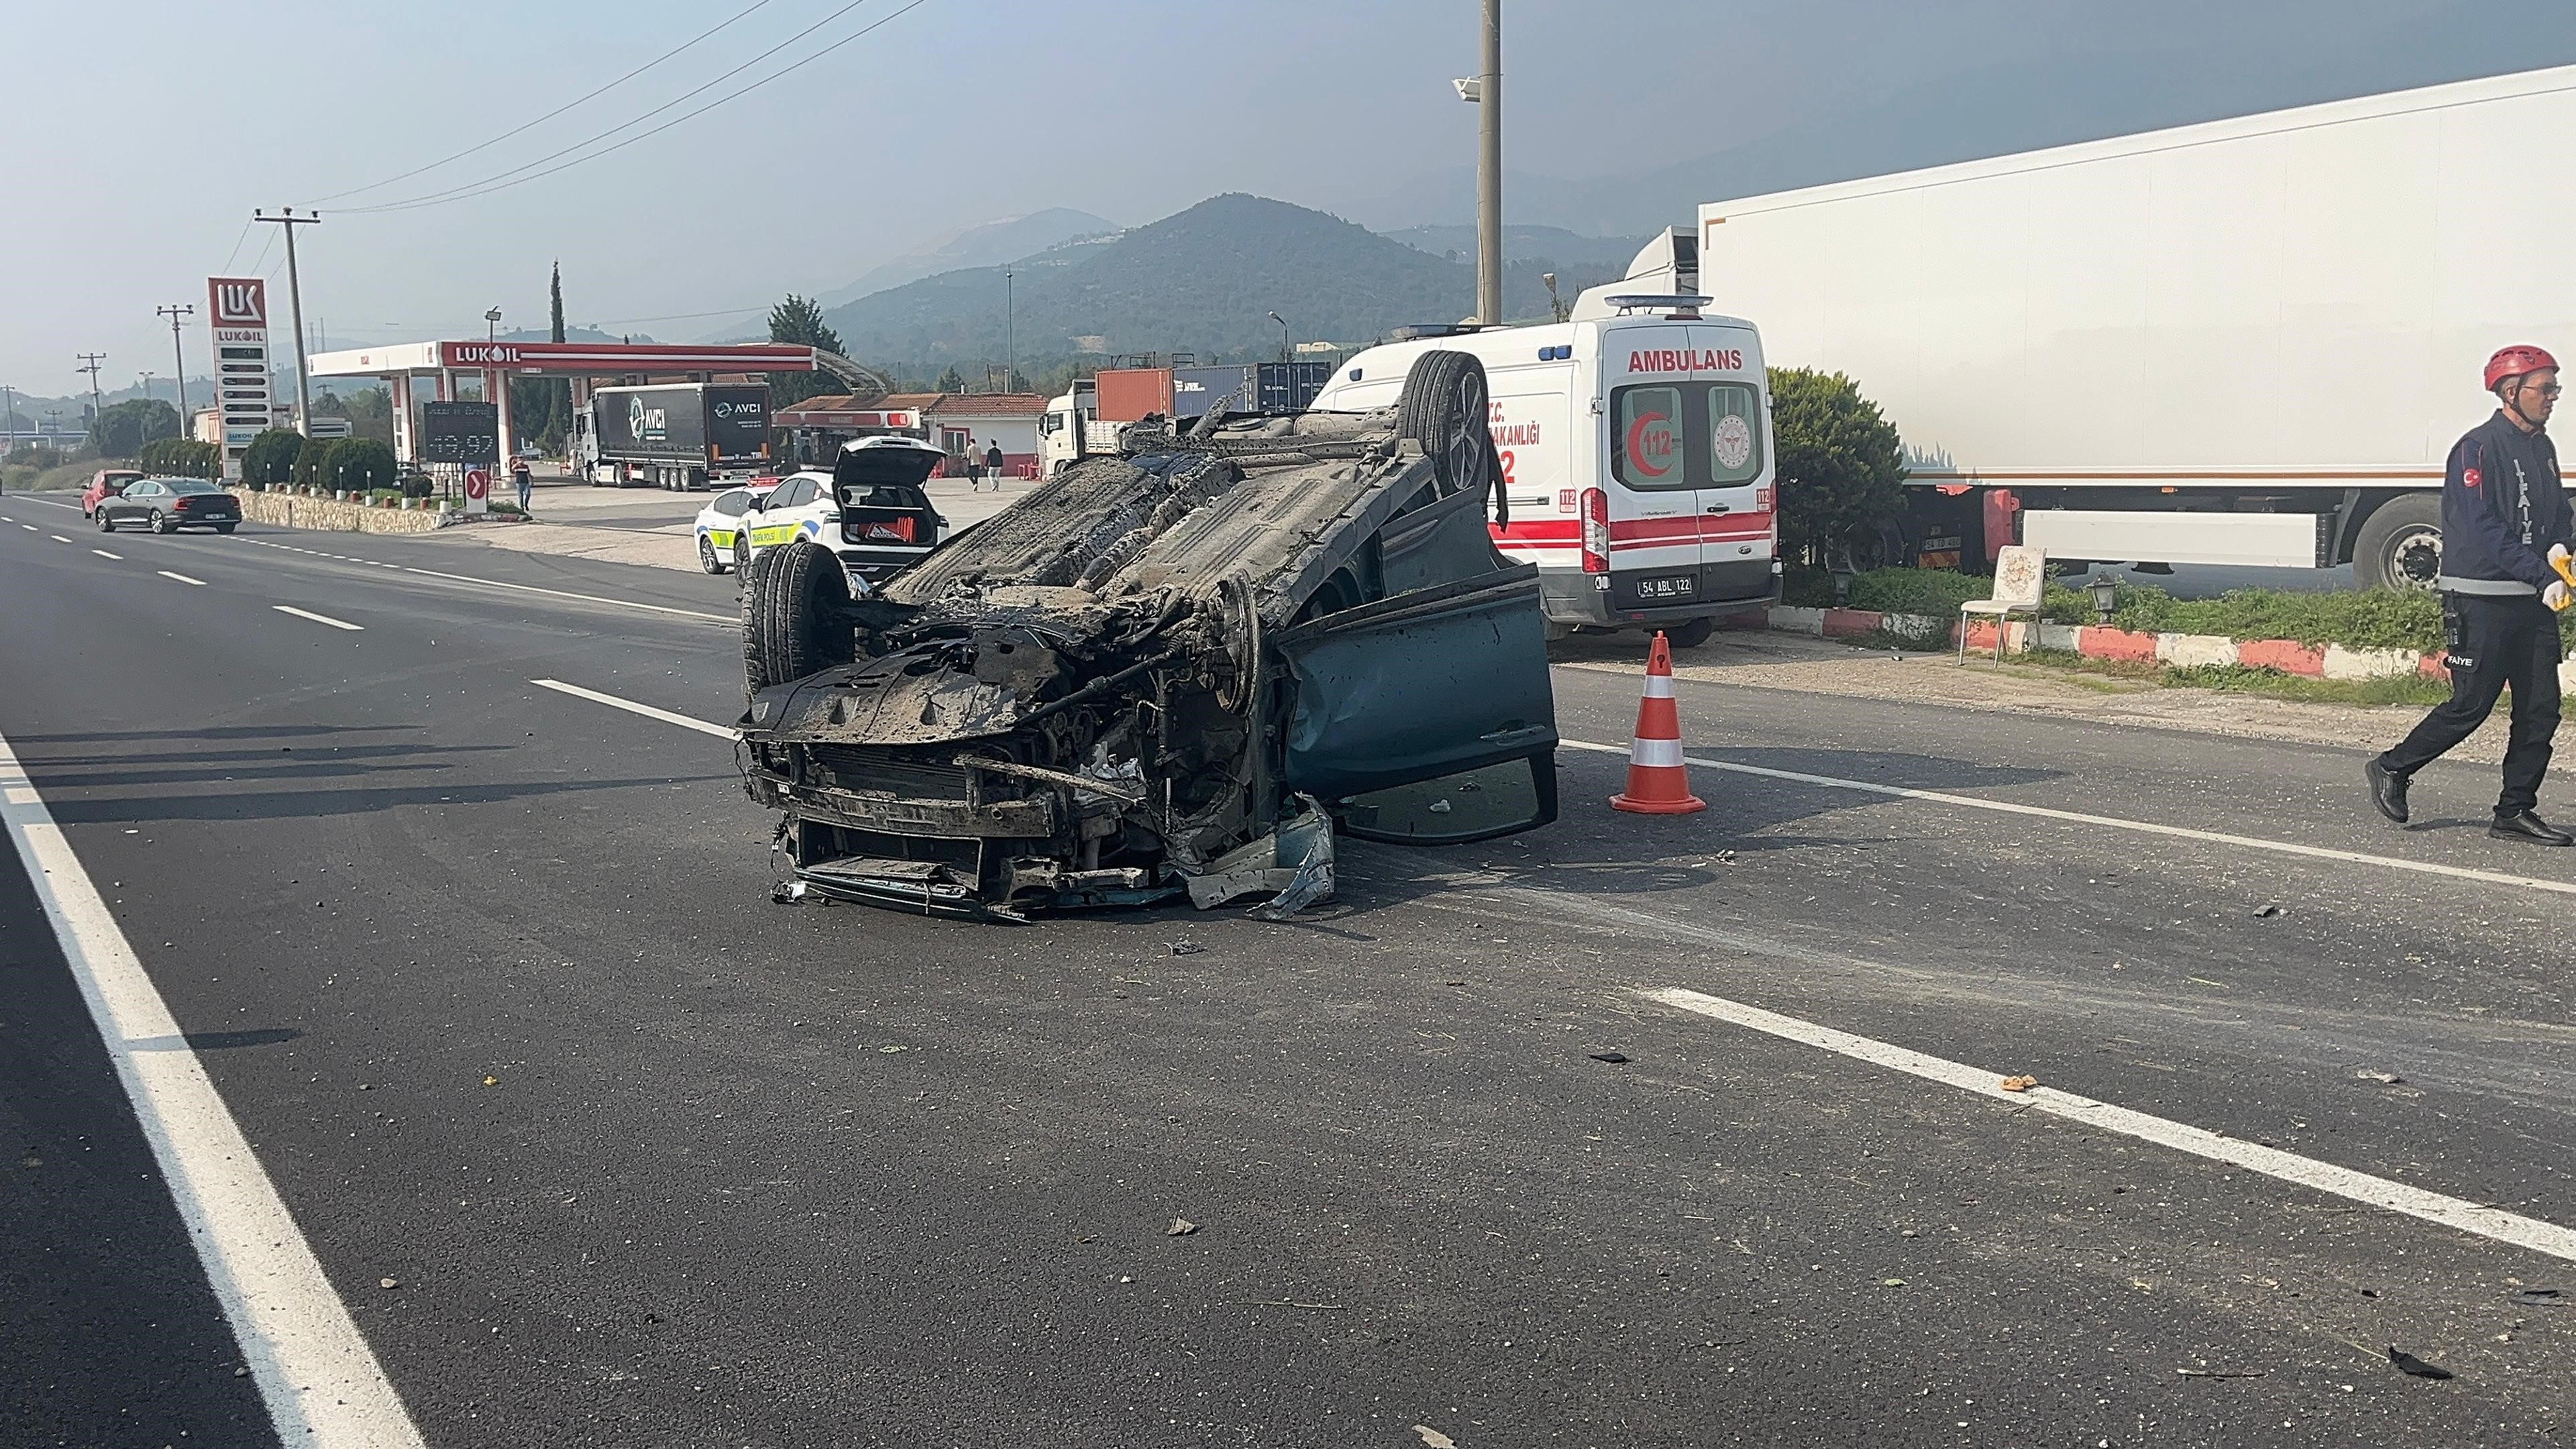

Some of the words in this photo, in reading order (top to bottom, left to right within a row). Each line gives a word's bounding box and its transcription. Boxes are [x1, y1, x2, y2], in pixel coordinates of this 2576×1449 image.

[217, 284, 263, 321] LUK
[219, 330, 263, 341] LUKOIL
[455, 345, 521, 362] LUKOIL
[1628, 350, 1742, 372] AMBULANS
[735, 403, 761, 413] AVCI
[645, 409, 665, 429] AVCI
[1489, 420, 1540, 447] AKANLIĞI
[1644, 430, 1672, 456] 112
[1560, 490, 1576, 504] 112
[1757, 490, 1770, 503] 112
[1642, 580, 1654, 593] 54
[1657, 580, 1672, 592] ABL
[1676, 579, 1690, 590] 122
